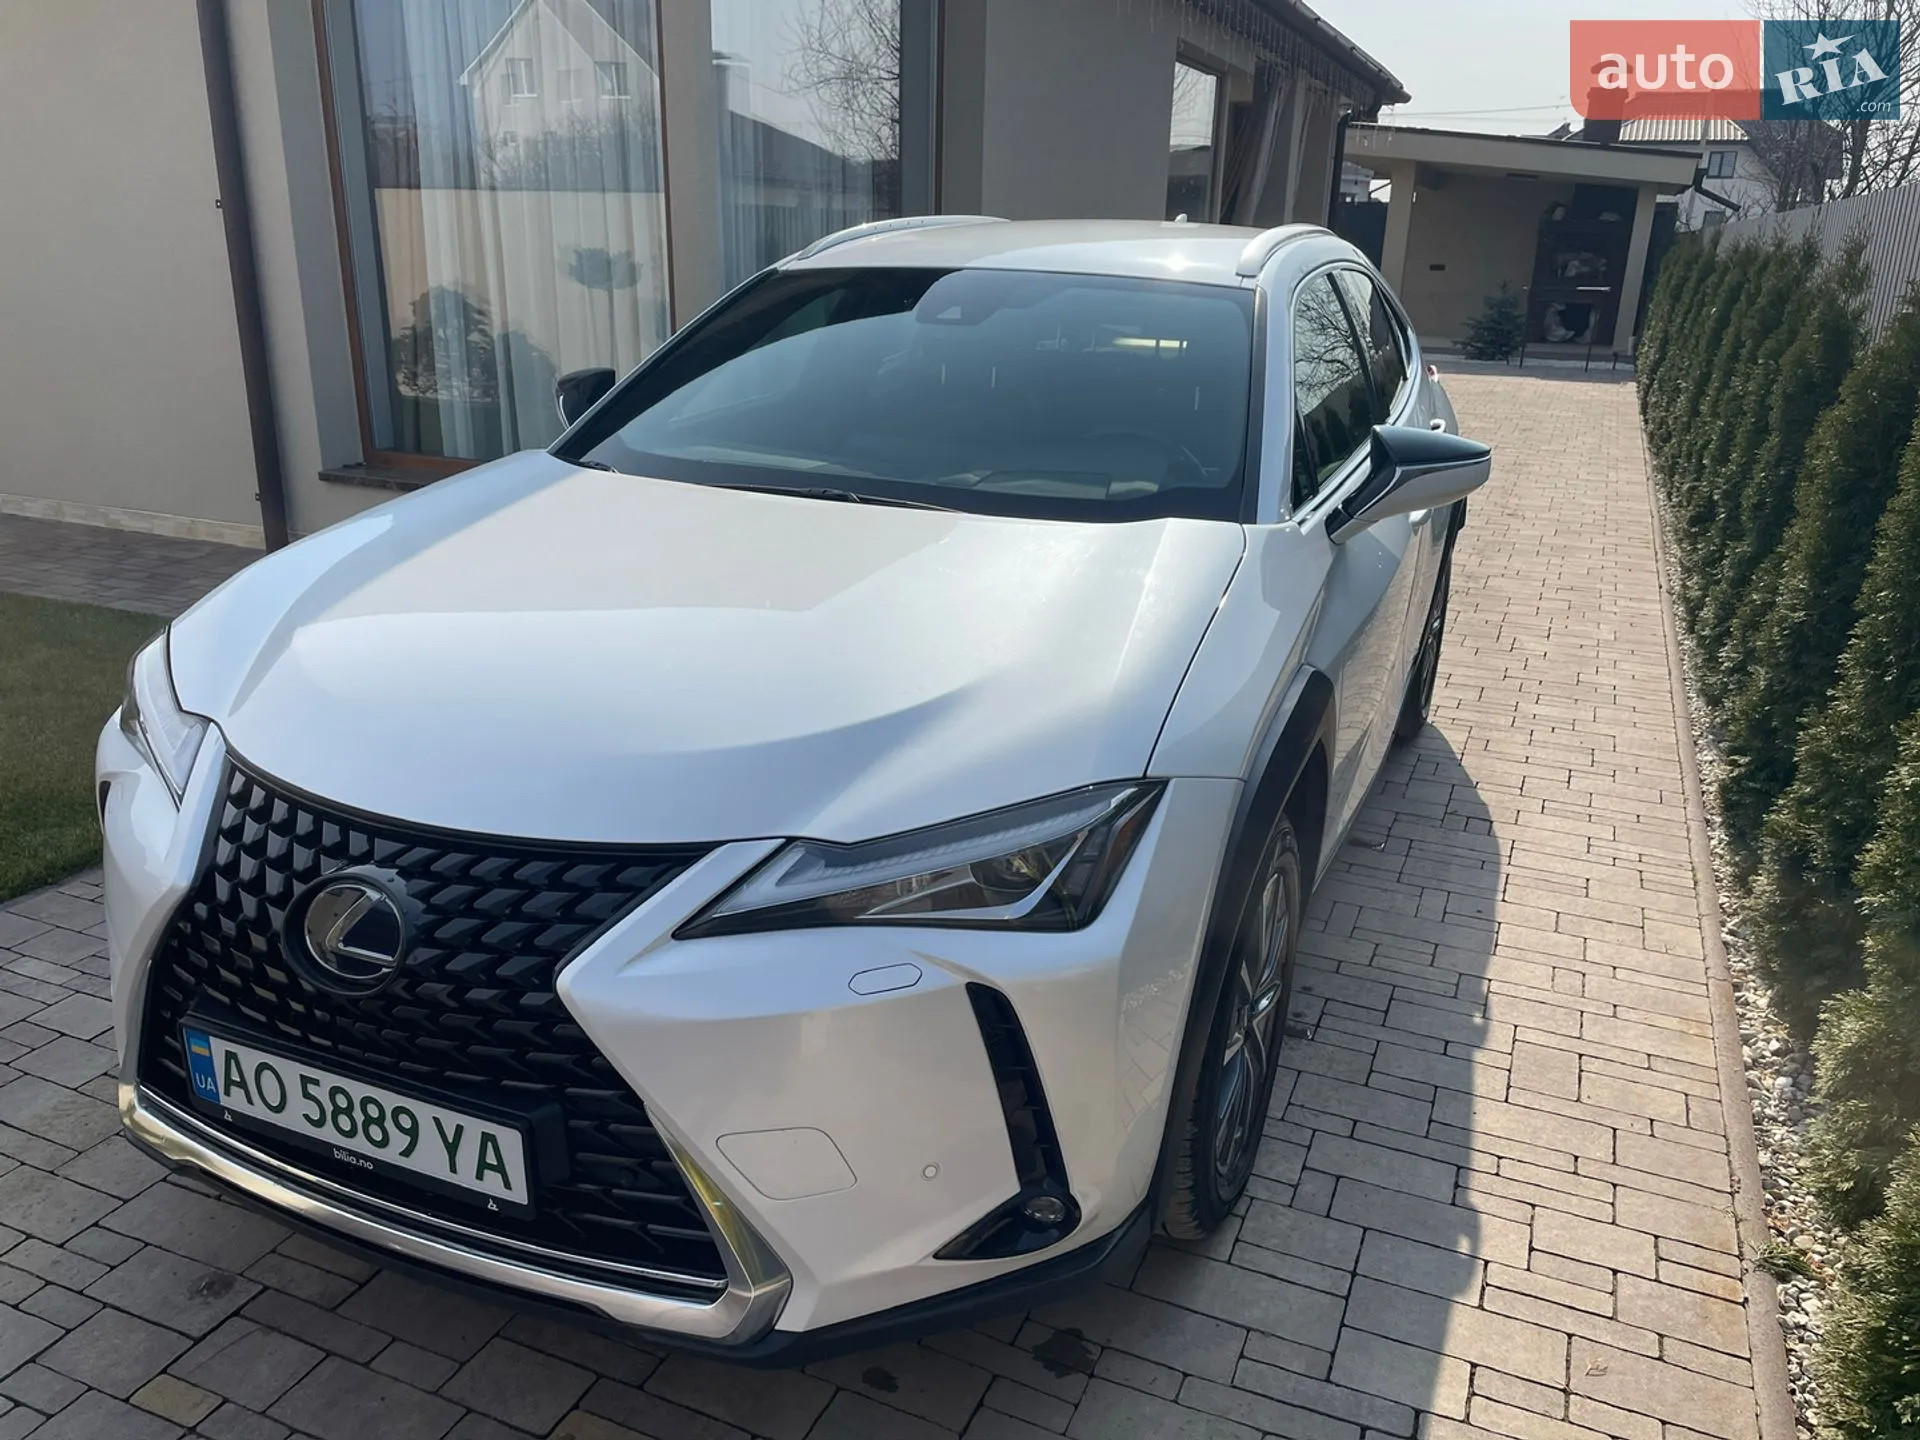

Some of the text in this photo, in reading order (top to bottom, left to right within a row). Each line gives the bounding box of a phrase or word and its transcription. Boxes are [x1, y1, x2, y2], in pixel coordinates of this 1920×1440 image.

[195, 1073, 216, 1093] UA
[223, 1049, 512, 1191] AO 5889 YA
[333, 1148, 374, 1170] bilia.no
